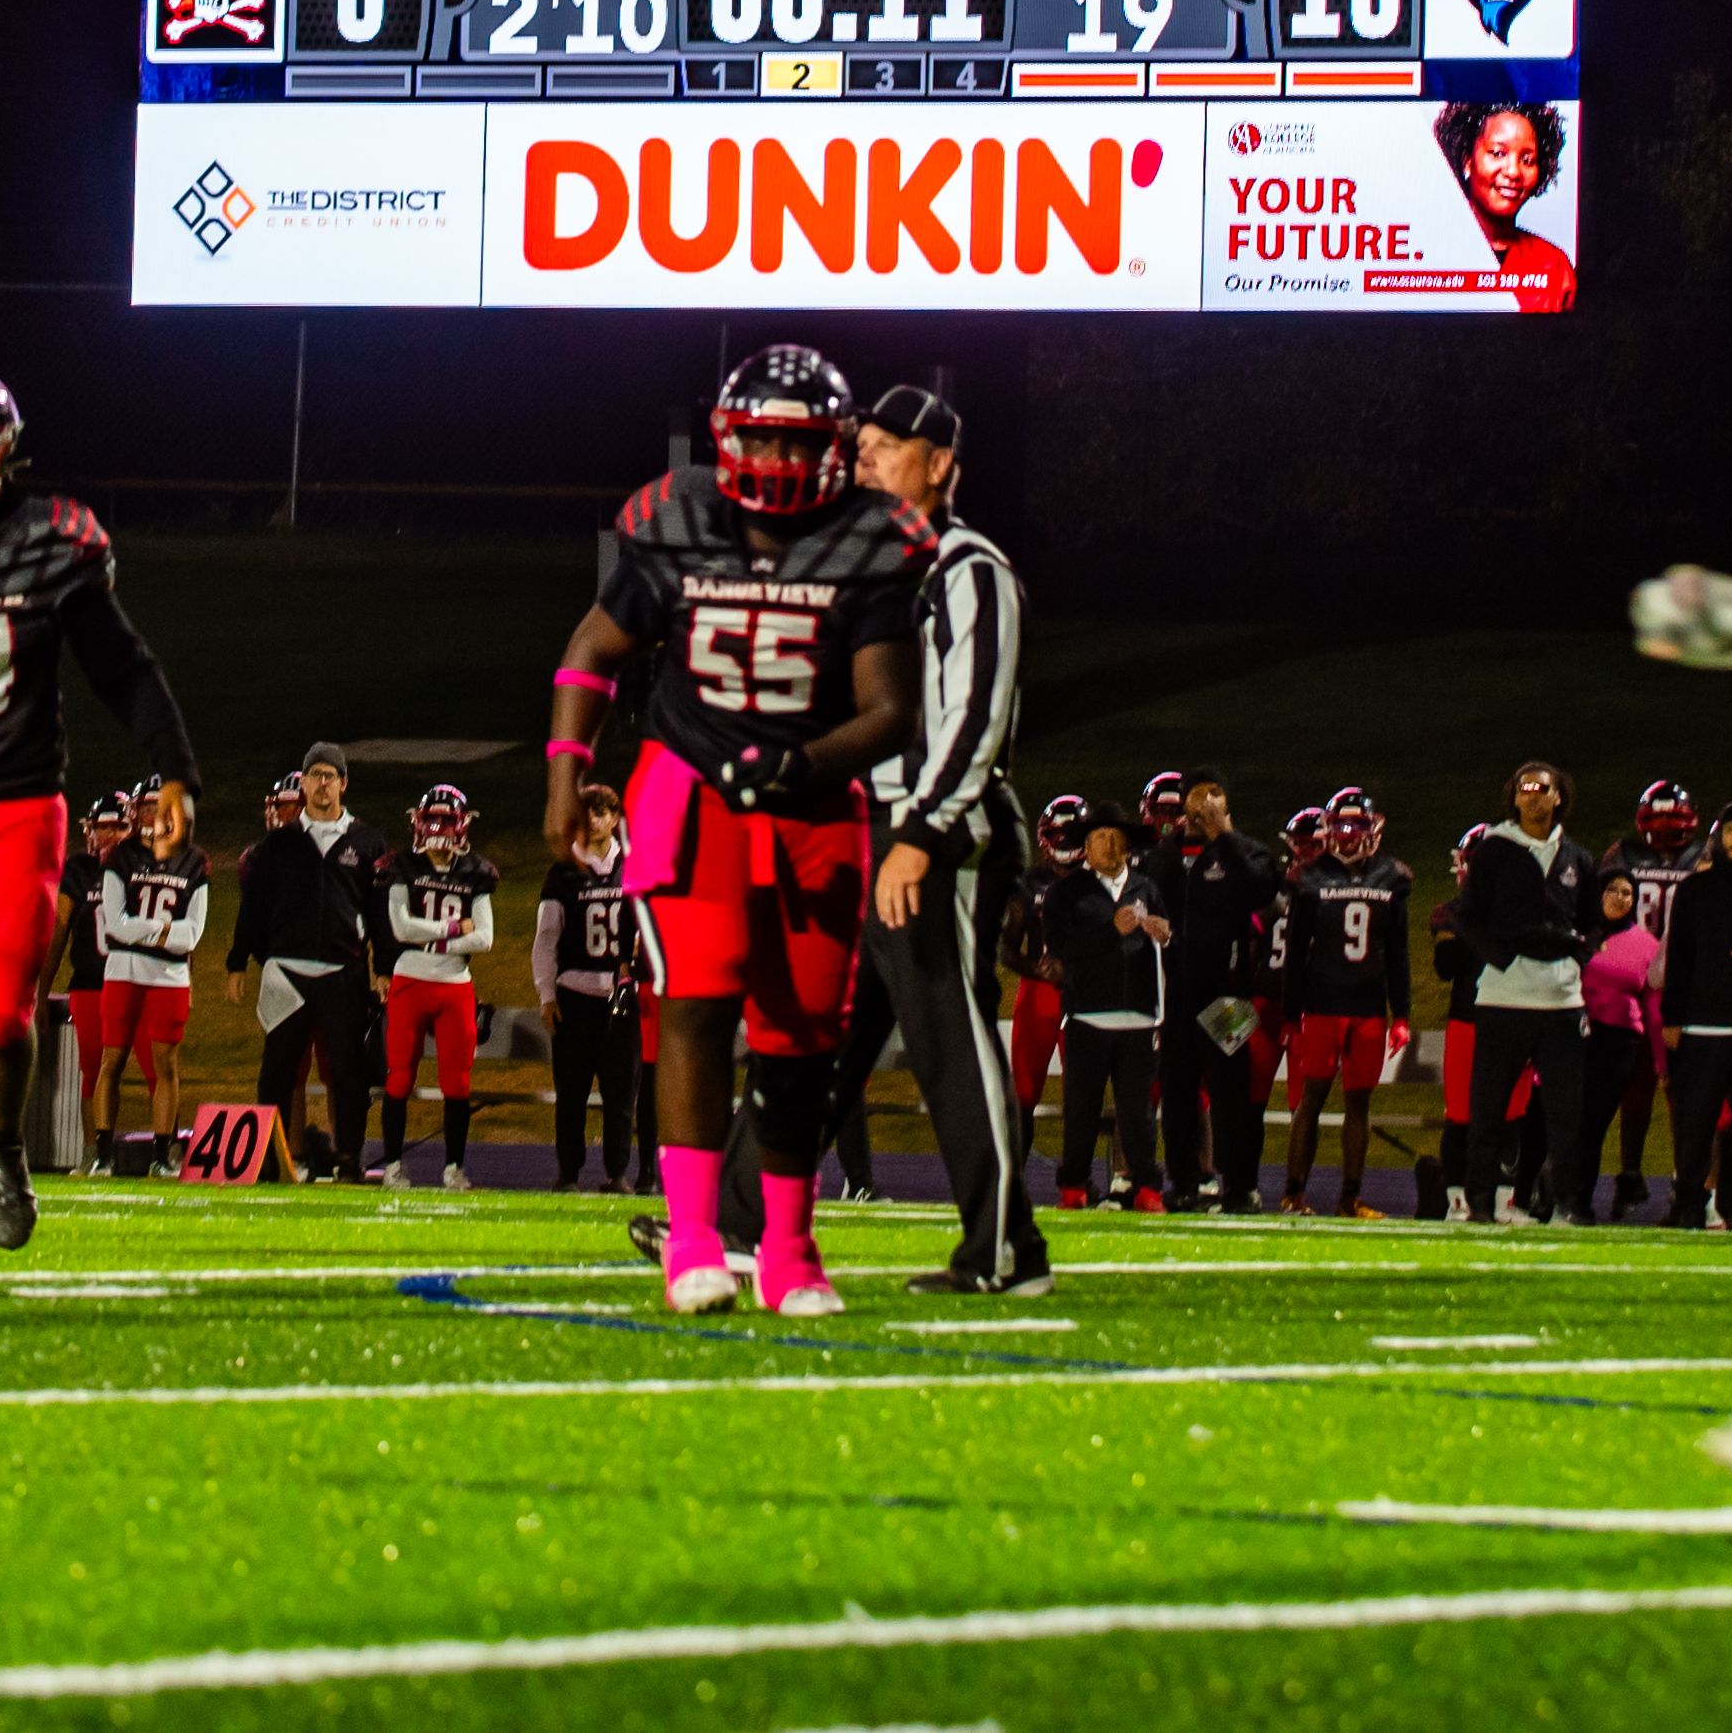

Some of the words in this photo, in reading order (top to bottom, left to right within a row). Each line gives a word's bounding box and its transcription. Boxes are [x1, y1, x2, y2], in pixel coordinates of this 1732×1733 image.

[711, 61, 727, 92] 1
[791, 62, 811, 91] 2
[874, 61, 896, 93] 3
[955, 61, 978, 93] 4
[522, 136, 1164, 276] DUNKIN'
[1228, 177, 1357, 215] YOUR
[266, 217, 353, 228] CREDIT
[372, 217, 447, 228] UNION
[1227, 224, 1425, 261] FUTURE.
[1224, 273, 1264, 292] Our
[689, 606, 818, 714] 55
[138, 885, 177, 922] 16
[1343, 900, 1370, 962] 9
[187, 1109, 260, 1180] 40
